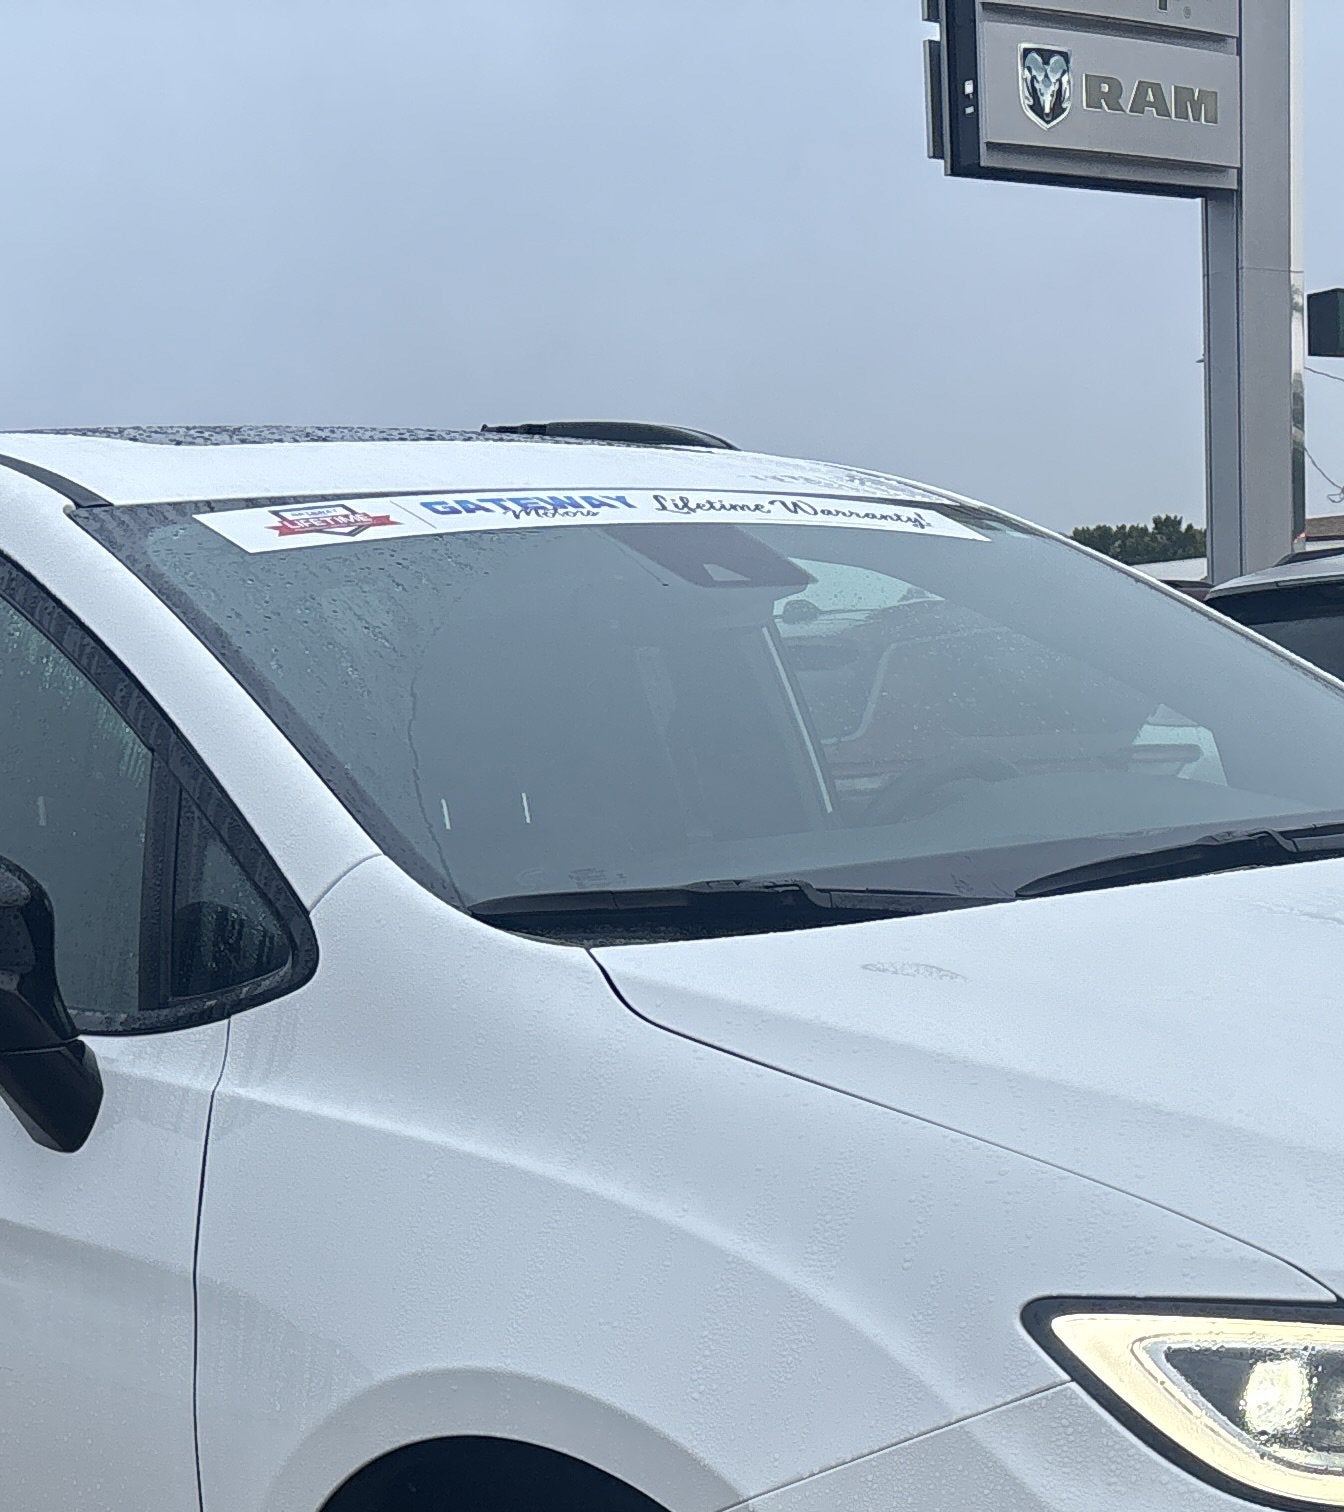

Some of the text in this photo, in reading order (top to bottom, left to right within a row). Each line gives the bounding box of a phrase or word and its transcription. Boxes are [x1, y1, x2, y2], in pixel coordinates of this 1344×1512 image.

[1082, 73, 1219, 125] RAM
[420, 495, 637, 515] GATEWAY
[503, 507, 600, 520] Motors
[652, 494, 932, 529] Lifetime Warranty!
[282, 512, 373, 529] LIFETIME
